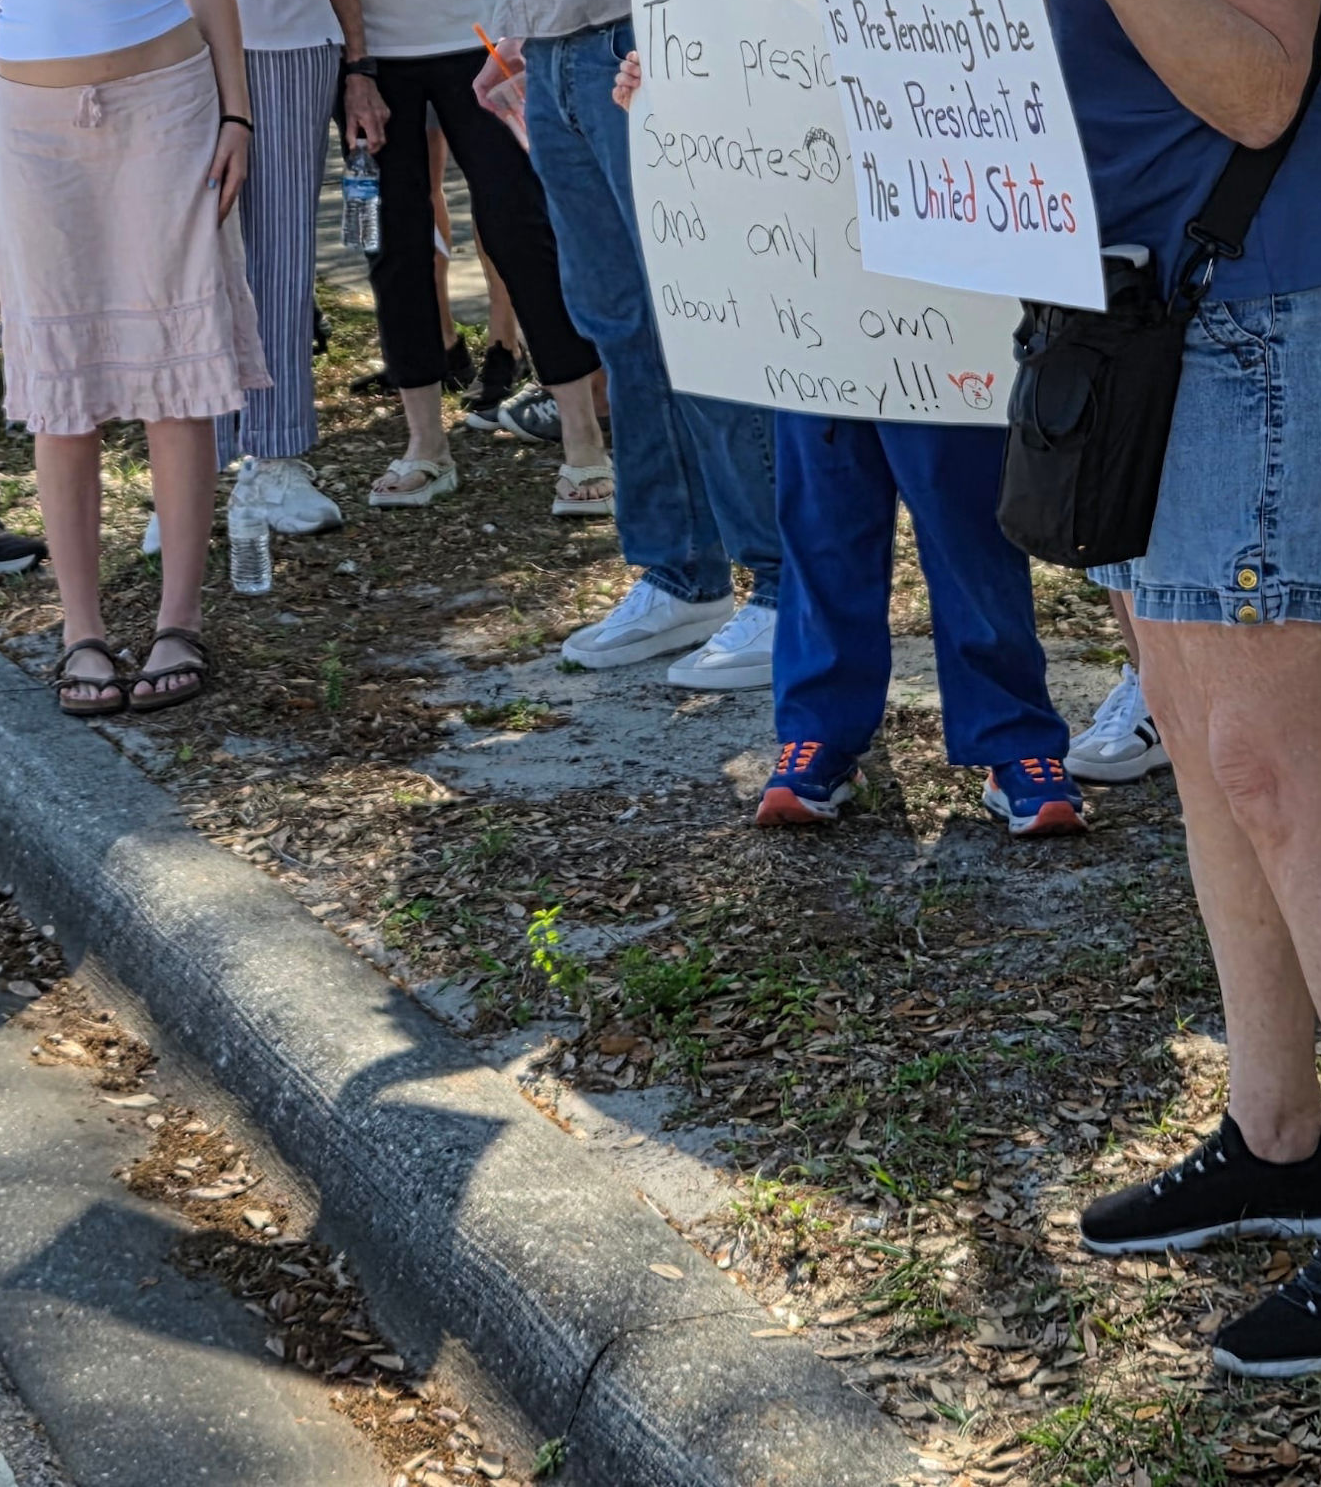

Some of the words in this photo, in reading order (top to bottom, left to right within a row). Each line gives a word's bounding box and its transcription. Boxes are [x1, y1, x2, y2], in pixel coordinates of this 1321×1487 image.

[840, 75, 892, 131] The
[904, 78, 1018, 141] President
[1024, 81, 1046, 134] of
[908, 157, 976, 223] United
[986, 162, 1076, 233] States
[652, 200, 706, 248] and
[746, 213, 817, 278] only
[662, 279, 740, 328] about
[771, 293, 822, 349] his
[859, 305, 954, 346] own
